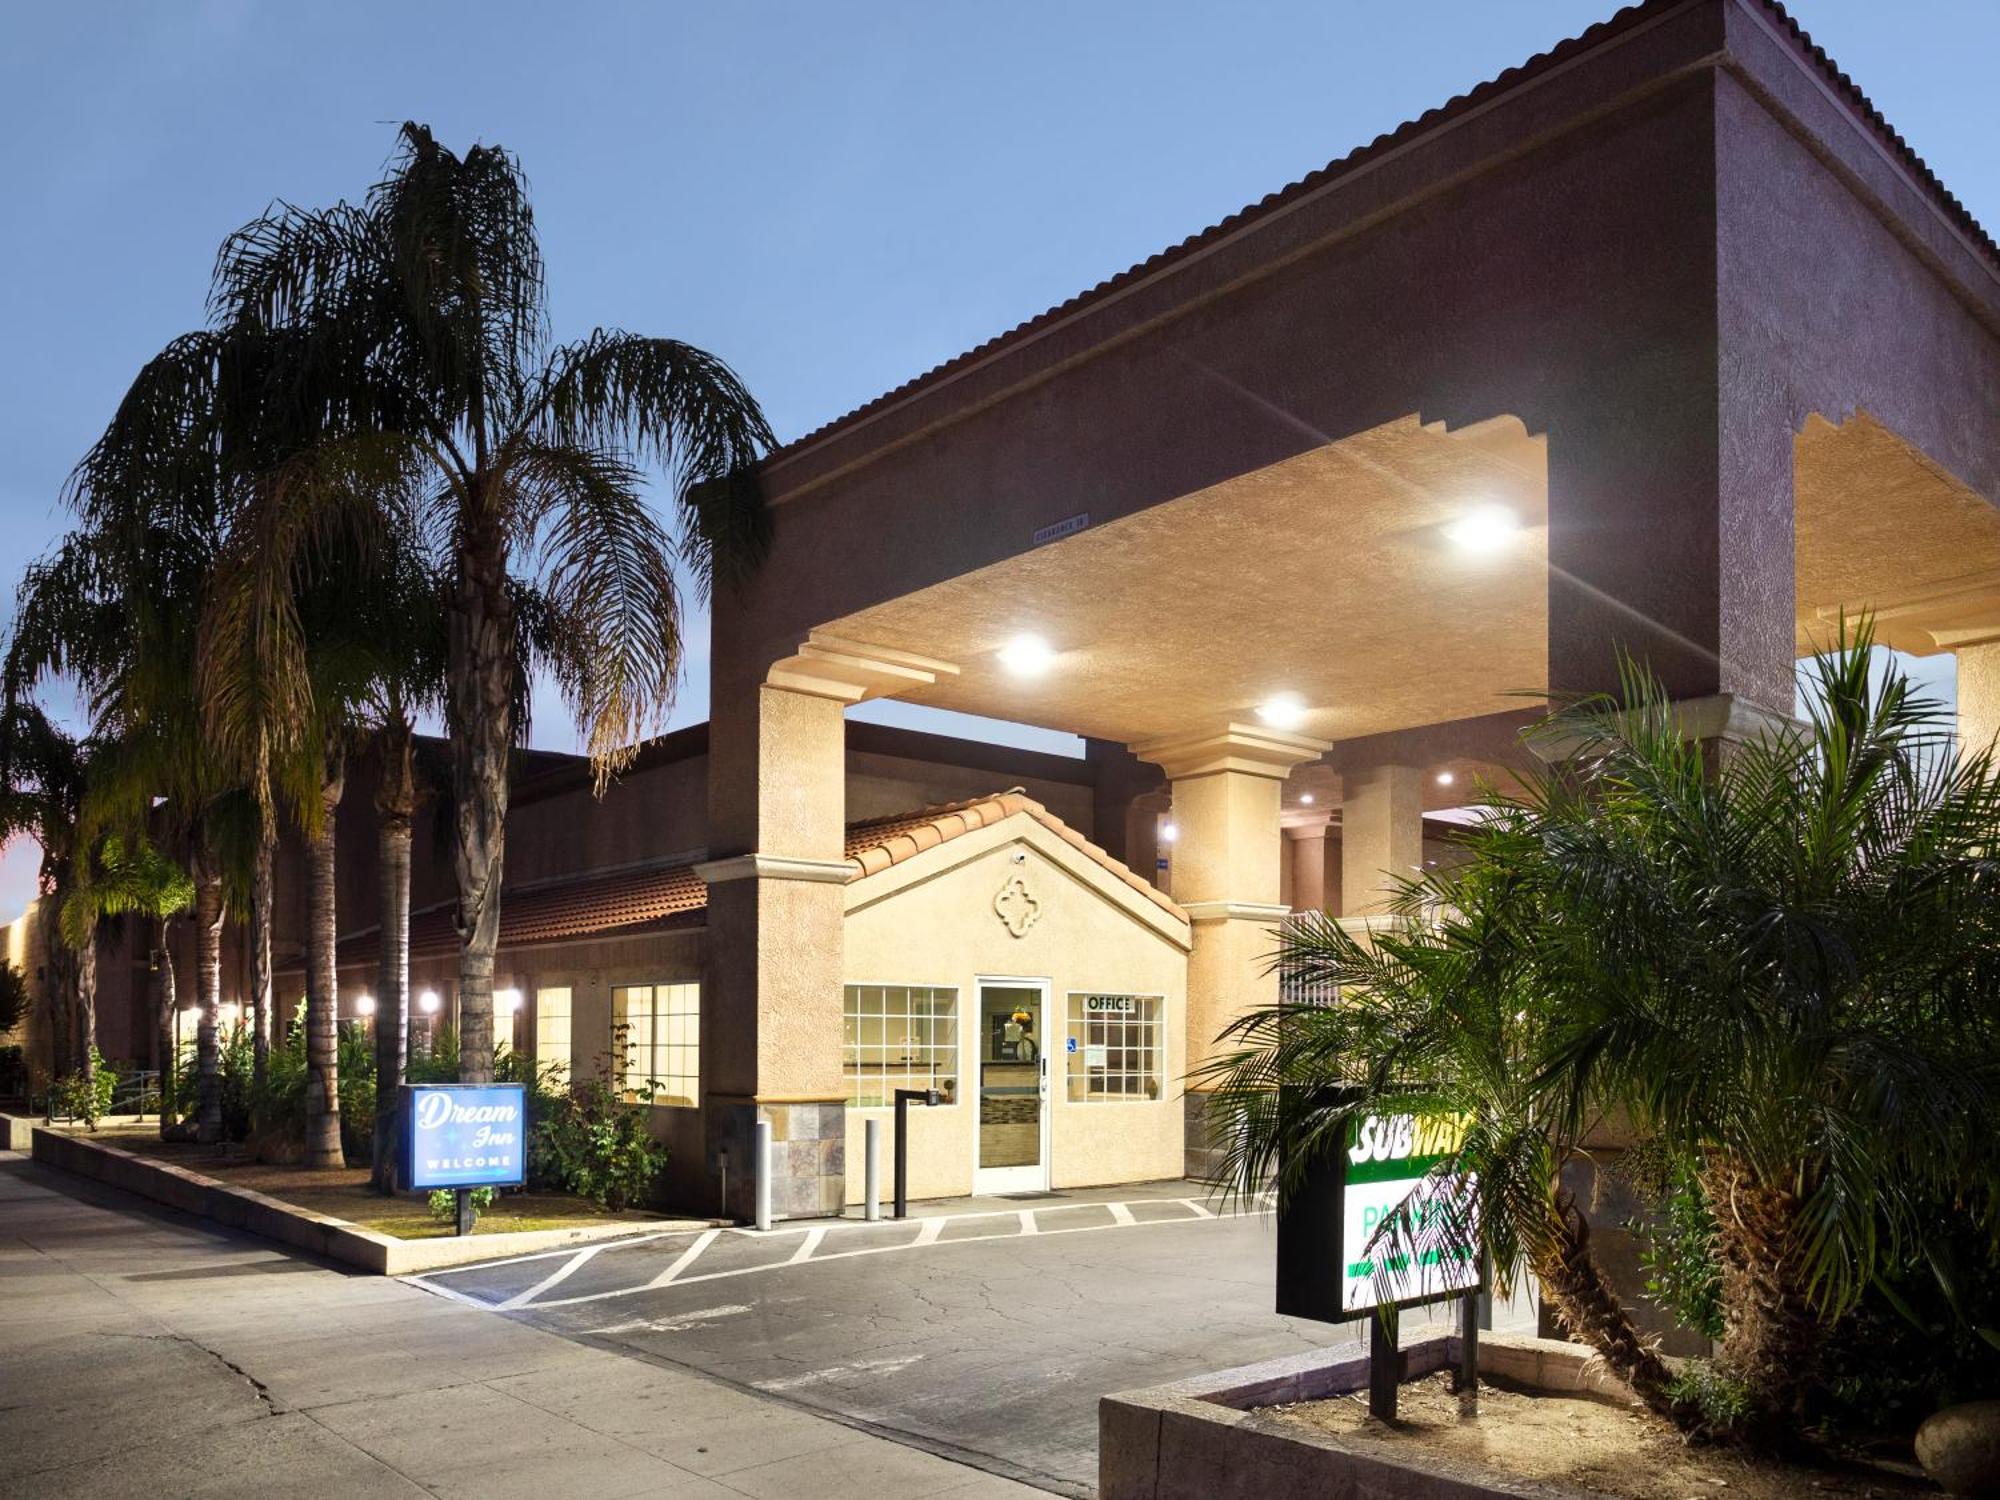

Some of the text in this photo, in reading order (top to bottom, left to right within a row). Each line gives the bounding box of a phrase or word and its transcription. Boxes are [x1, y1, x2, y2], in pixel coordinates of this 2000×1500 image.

[1088, 996, 1130, 1010] OFFICE
[418, 1092, 518, 1130] Dream
[472, 1126, 515, 1148] Inn
[1348, 1108, 1478, 1166] SUBWAY
[426, 1156, 511, 1169] WELCOME
